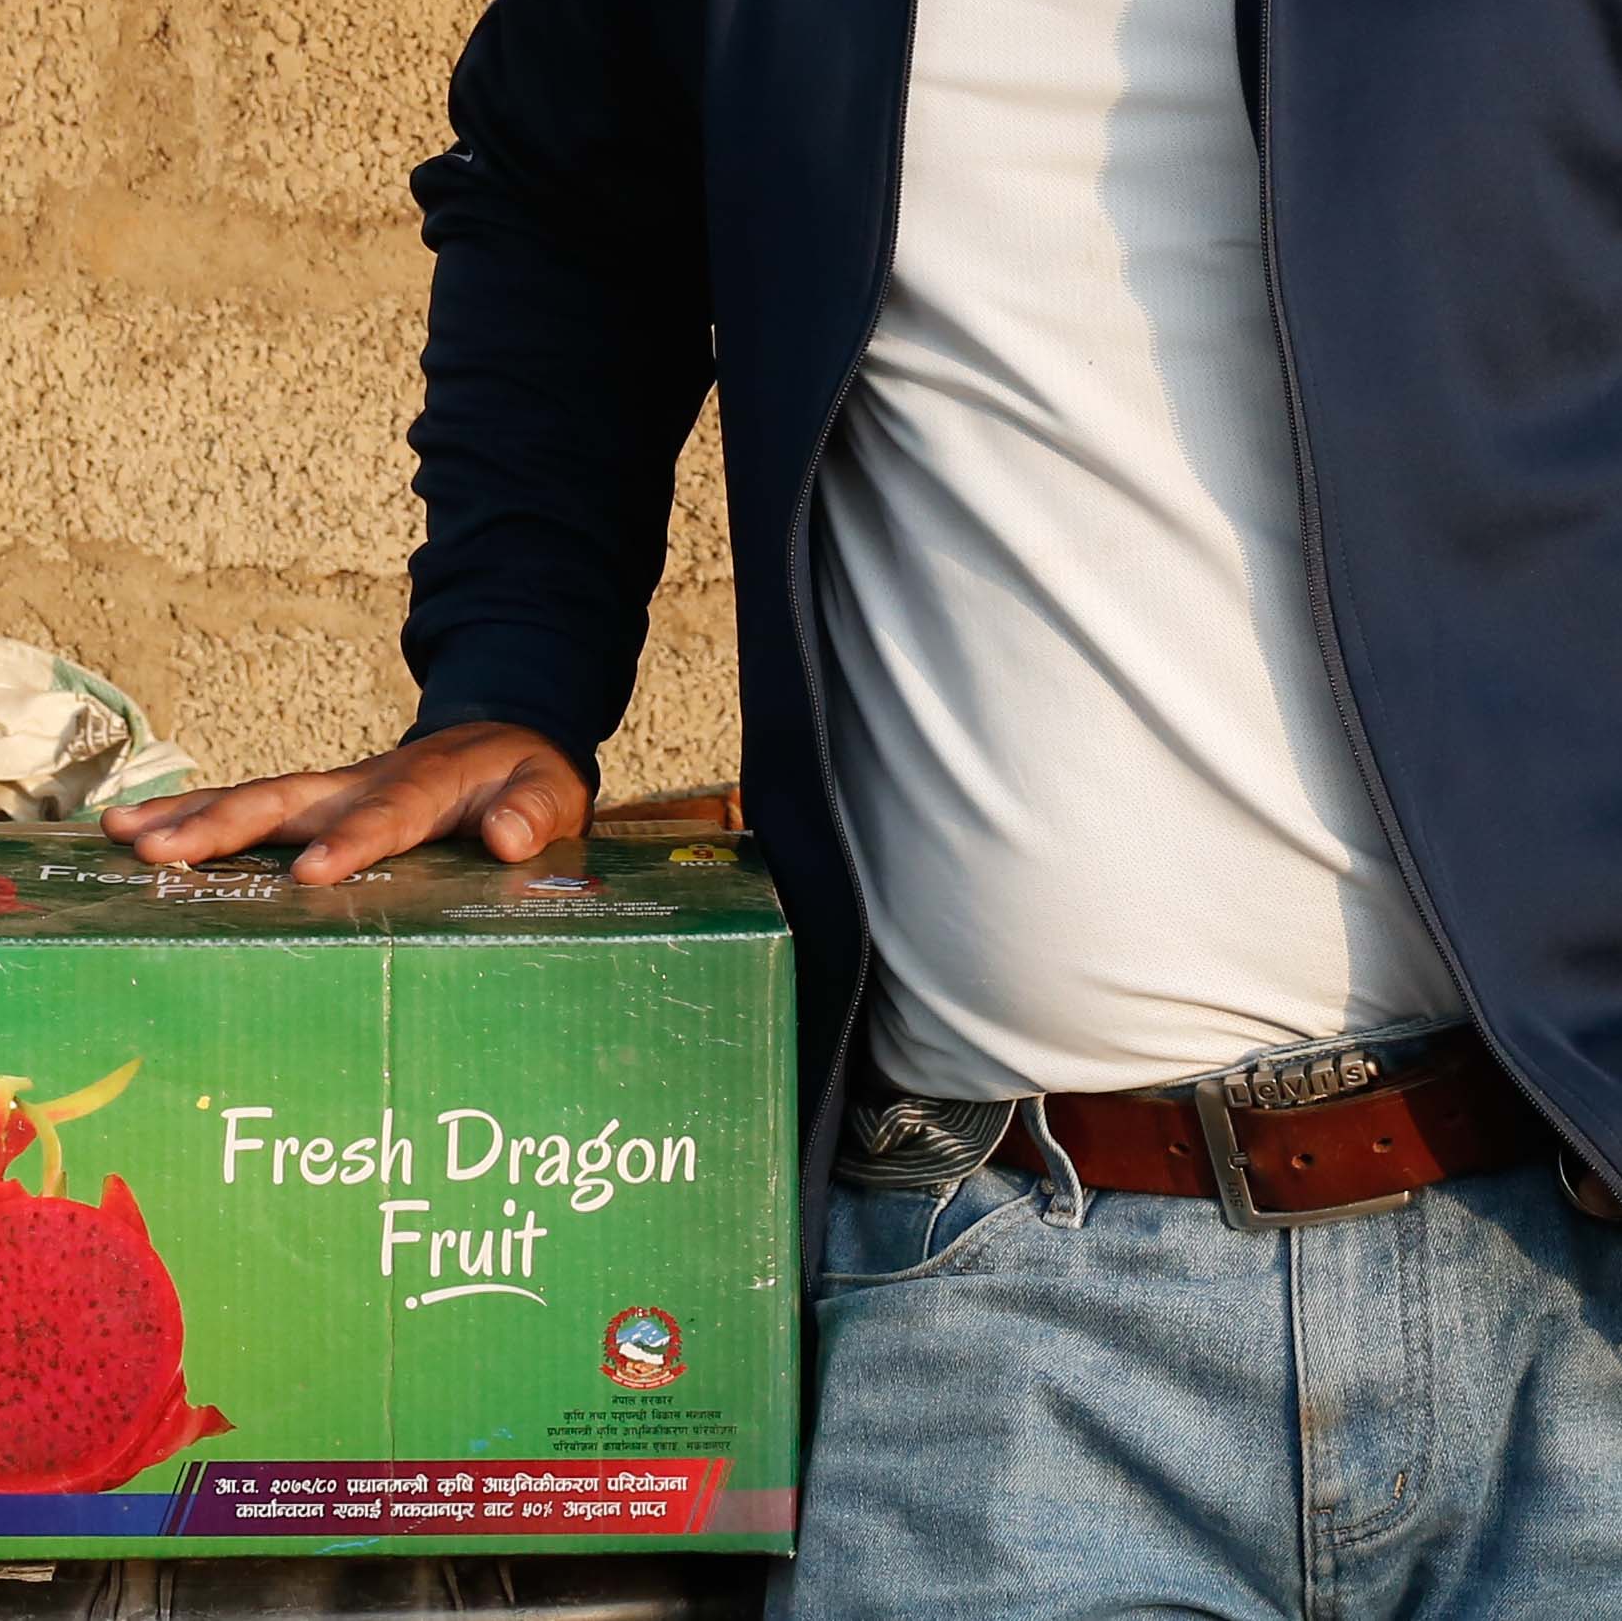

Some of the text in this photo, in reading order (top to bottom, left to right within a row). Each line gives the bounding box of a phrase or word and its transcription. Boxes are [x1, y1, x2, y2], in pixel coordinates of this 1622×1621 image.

[39, 865, 181, 885] Fresh
[156, 884, 281, 899] Fruit
[220, 1106, 696, 1212] Fresh Dragon
[378, 1198, 548, 1278] Fruit
[346, 1474, 429, 1496] प्रधानमन्त्री
[437, 1473, 473, 1497] कृषि
[482, 1473, 598, 1497] आधुनिकीकरण
[607, 1473, 688, 1493] परियोजना
[235, 1499, 324, 1519] कार्यान्वयन
[390, 1503, 475, 1522] मकवानपुर
[563, 1501, 621, 1520] अनुदान
[629, 1501, 667, 1519] प्राप्त
